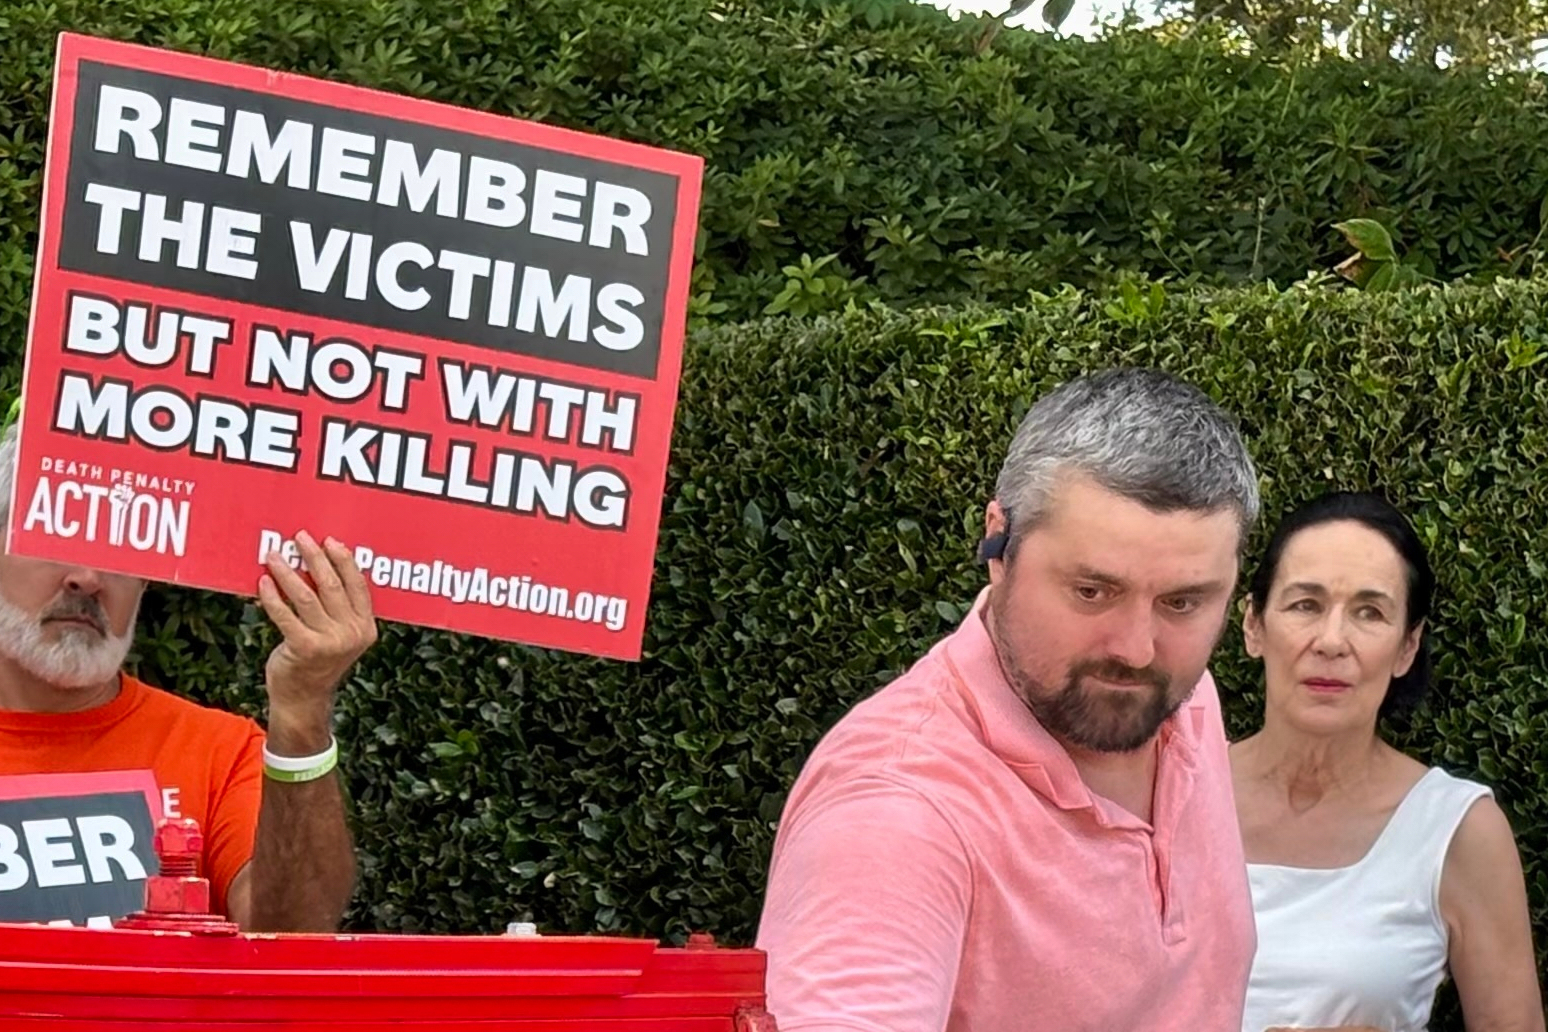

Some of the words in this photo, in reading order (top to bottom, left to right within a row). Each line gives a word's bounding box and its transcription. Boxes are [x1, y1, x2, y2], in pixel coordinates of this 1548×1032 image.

[93, 85, 653, 256] REMEMBER
[85, 183, 262, 280] THE
[289, 220, 646, 351] VICTIMS
[66, 296, 230, 375] BUT
[251, 330, 422, 408] NOT
[443, 364, 639, 451] WITH
[23, 476, 190, 557] ACTION
[41, 457, 102, 480] DEATH
[110, 468, 196, 495] PENALTY
[56, 378, 300, 467] MORE
[322, 422, 628, 527] KILLING
[258, 529, 628, 631] DePenaltyAction.org
